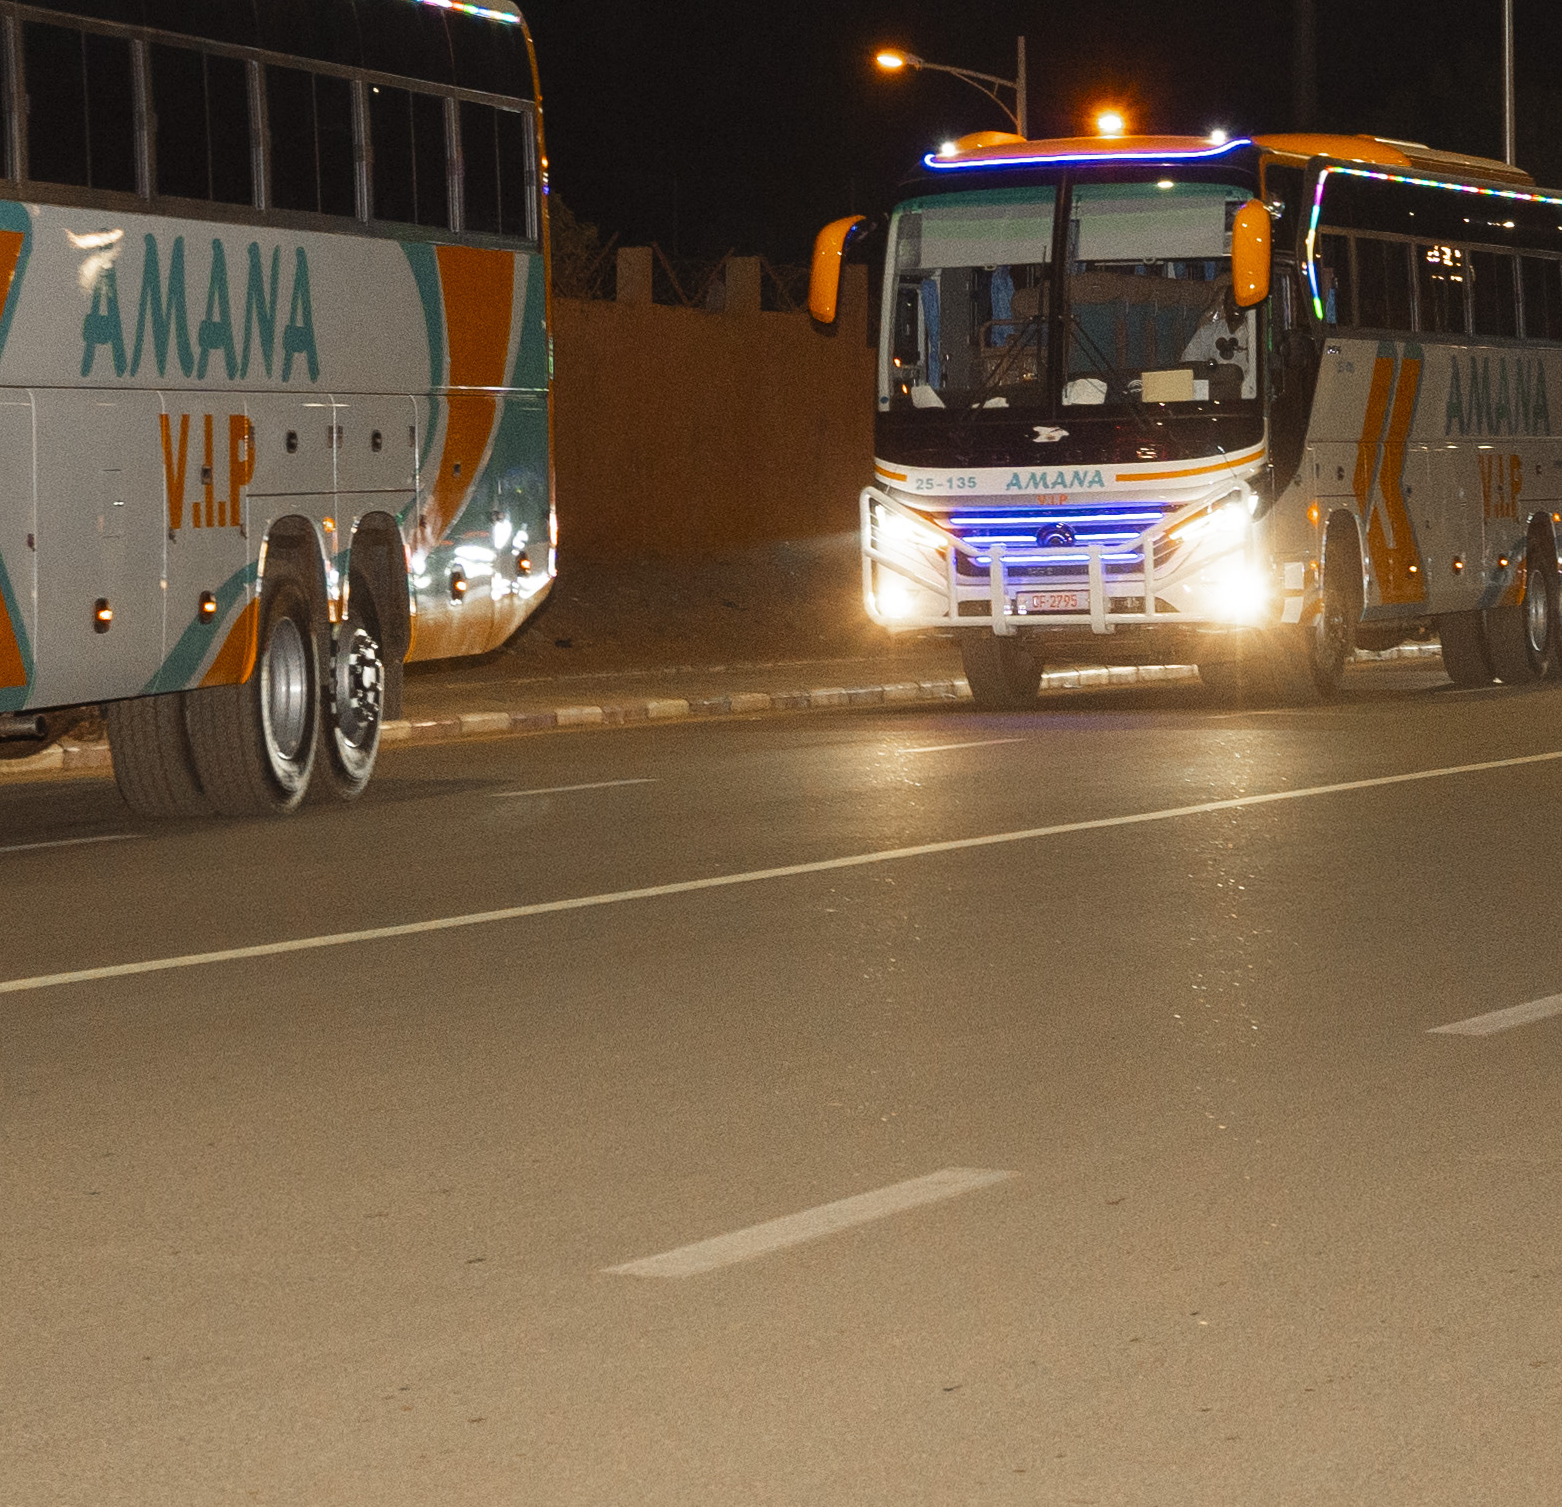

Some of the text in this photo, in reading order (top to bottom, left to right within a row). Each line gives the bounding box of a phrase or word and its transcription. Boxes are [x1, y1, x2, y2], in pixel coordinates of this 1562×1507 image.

[80, 228, 319, 383] AMANA
[1445, 354, 1551, 436] AMANA
[159, 413, 256, 529] V.I.P
[916, 476, 977, 490] 25-135
[1005, 469, 1105, 491] AMANA
